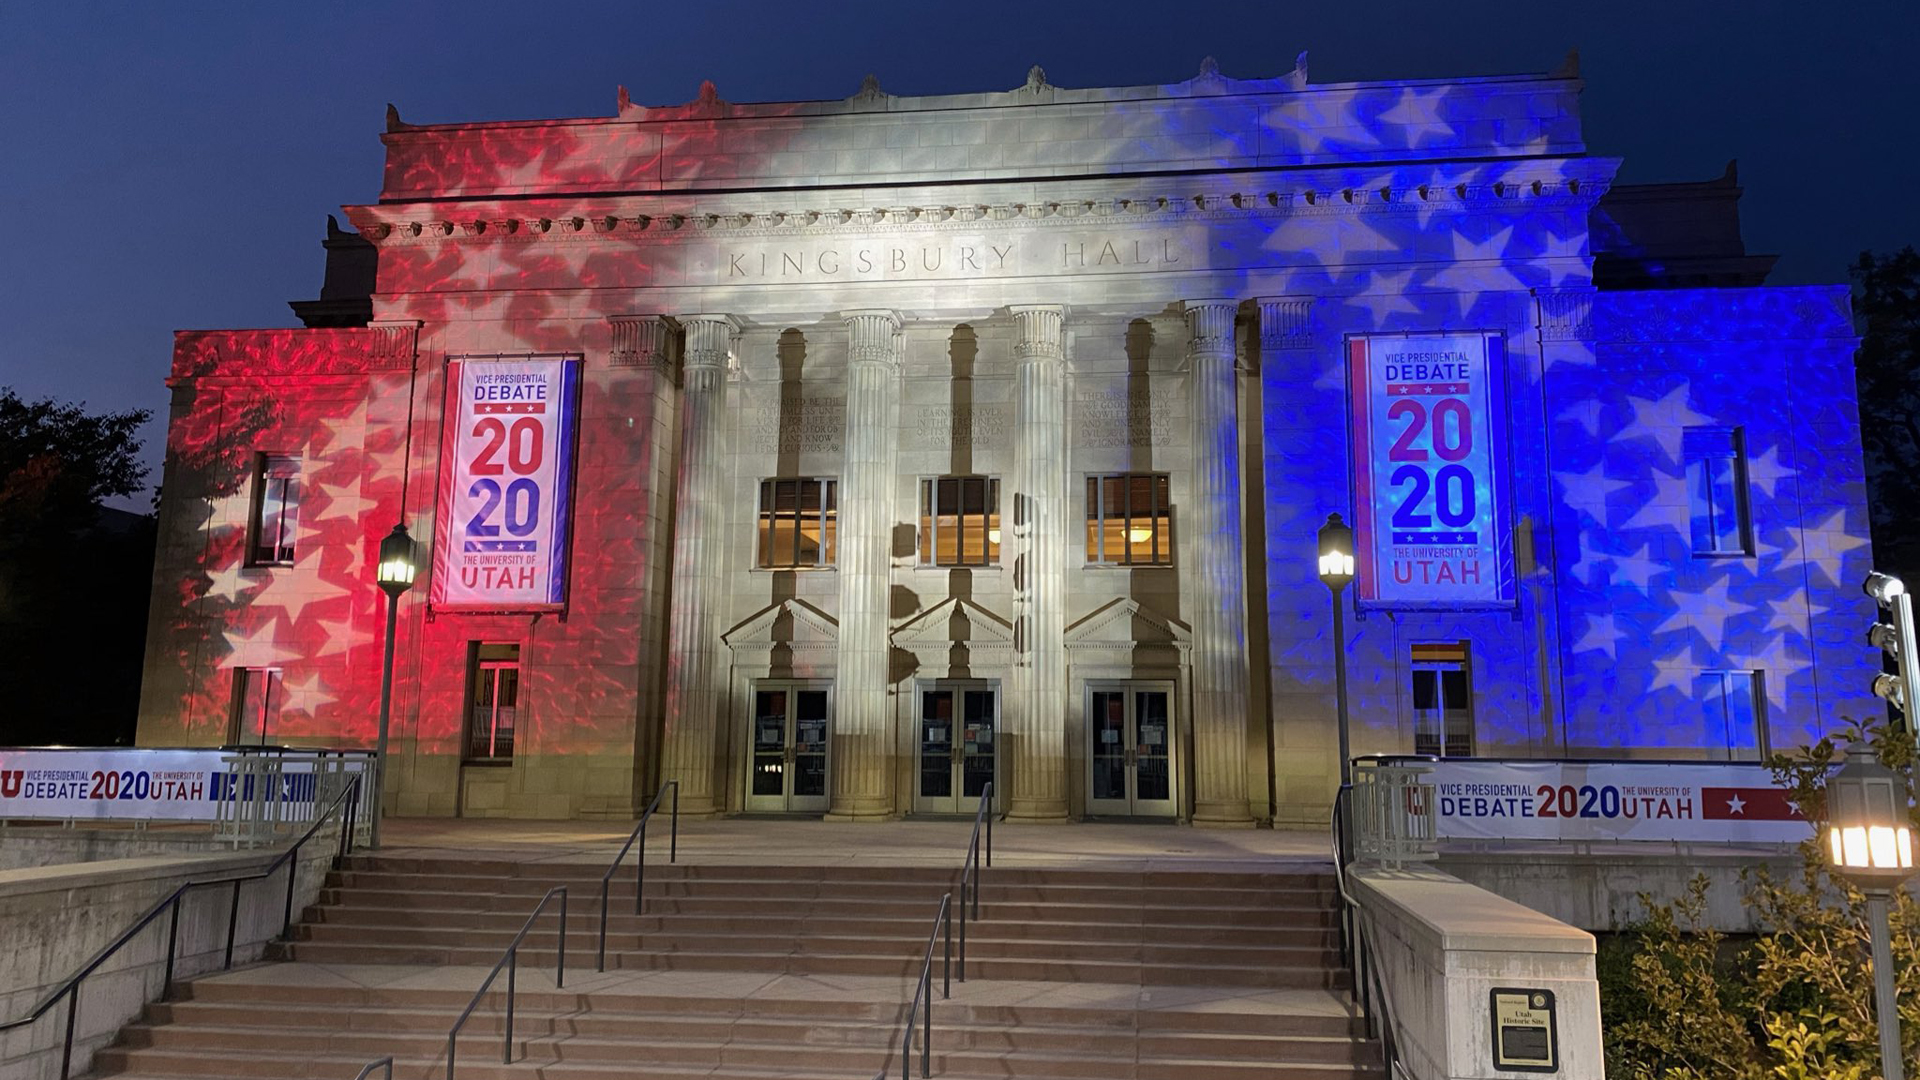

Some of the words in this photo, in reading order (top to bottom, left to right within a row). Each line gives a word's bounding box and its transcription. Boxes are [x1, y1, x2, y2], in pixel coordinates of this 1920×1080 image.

[729, 245, 1012, 277] KINGSBURY
[1063, 239, 1179, 266] HALL
[1385, 353, 1406, 364] VICE
[1407, 351, 1470, 363] PRESIDENTIAL
[476, 375, 493, 385] VICE
[494, 374, 547, 384] PRESIDENTIAL
[1385, 363, 1470, 381] DEBATE
[474, 385, 547, 400] DEBATE
[809, 397, 820, 406] BE
[1100, 401, 1127, 409] GOOD
[1387, 398, 1473, 462] 20
[469, 417, 544, 475] 20
[1390, 464, 1477, 528] 20
[465, 478, 541, 537] 20
[464, 556, 478, 566] THE
[480, 555, 524, 565] UNIVERSITY
[526, 555, 536, 565] OF
[1393, 548, 1410, 559] THE
[1412, 547, 1464, 558] UNIVERSITY
[1466, 547, 1479, 558] OF
[461, 567, 535, 589] UTAH
[1394, 561, 1480, 584] UTAH
[1, 770, 24, 798] U
[27, 770, 42, 781] VICE
[43, 770, 89, 781] PRESIDENTIAL
[152, 772, 162, 780] THE
[163, 772, 196, 780] UNIVERSITY
[197, 772, 205, 780] OF
[24, 782, 89, 799] DEBATE
[90, 770, 150, 800] 2020
[150, 781, 203, 800] UTAH
[1440, 784, 1462, 796] VICE
[1465, 784, 1533, 797] PRESIDENTIAL
[1622, 786, 1636, 796] THE
[1638, 786, 1680, 797] UNIVERSITY
[1682, 787, 1692, 797] OF
[1440, 798, 1535, 818] DEBATE
[1537, 785, 1620, 819] 2020
[1622, 797, 1693, 819] UTAH
[1503, 1017, 1530, 1025] Historic
[1532, 1018, 1545, 1026] Site
[1515, 1010, 1532, 1018] Utah
